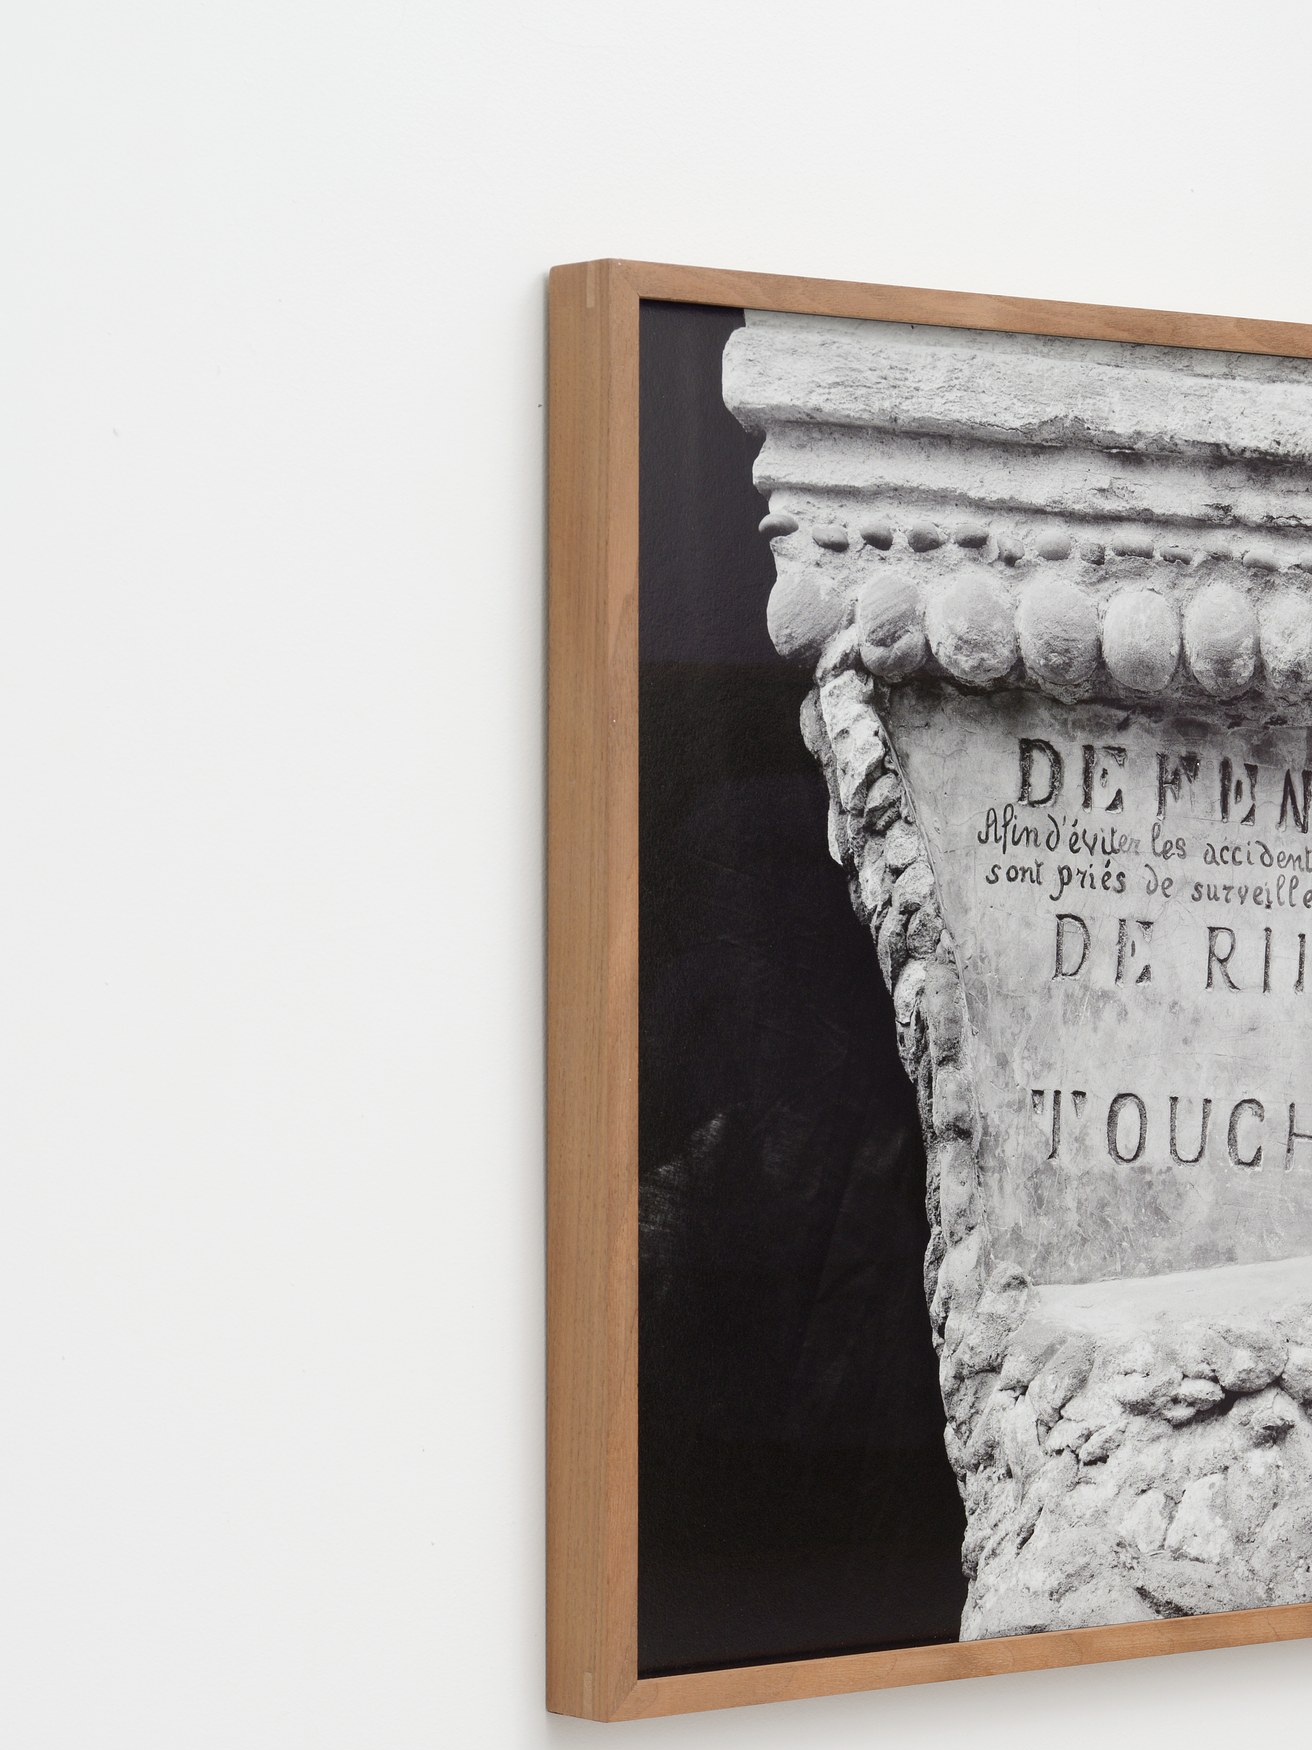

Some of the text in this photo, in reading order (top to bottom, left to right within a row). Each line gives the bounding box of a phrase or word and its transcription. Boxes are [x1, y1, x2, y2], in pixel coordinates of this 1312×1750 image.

[978, 805, 1041, 854] Afin
[1152, 821, 1186, 860] les
[986, 859, 1044, 885] sont
[1050, 859, 1126, 901] priés
[1145, 864, 1173, 898] de
[1052, 913, 1155, 985] DE
